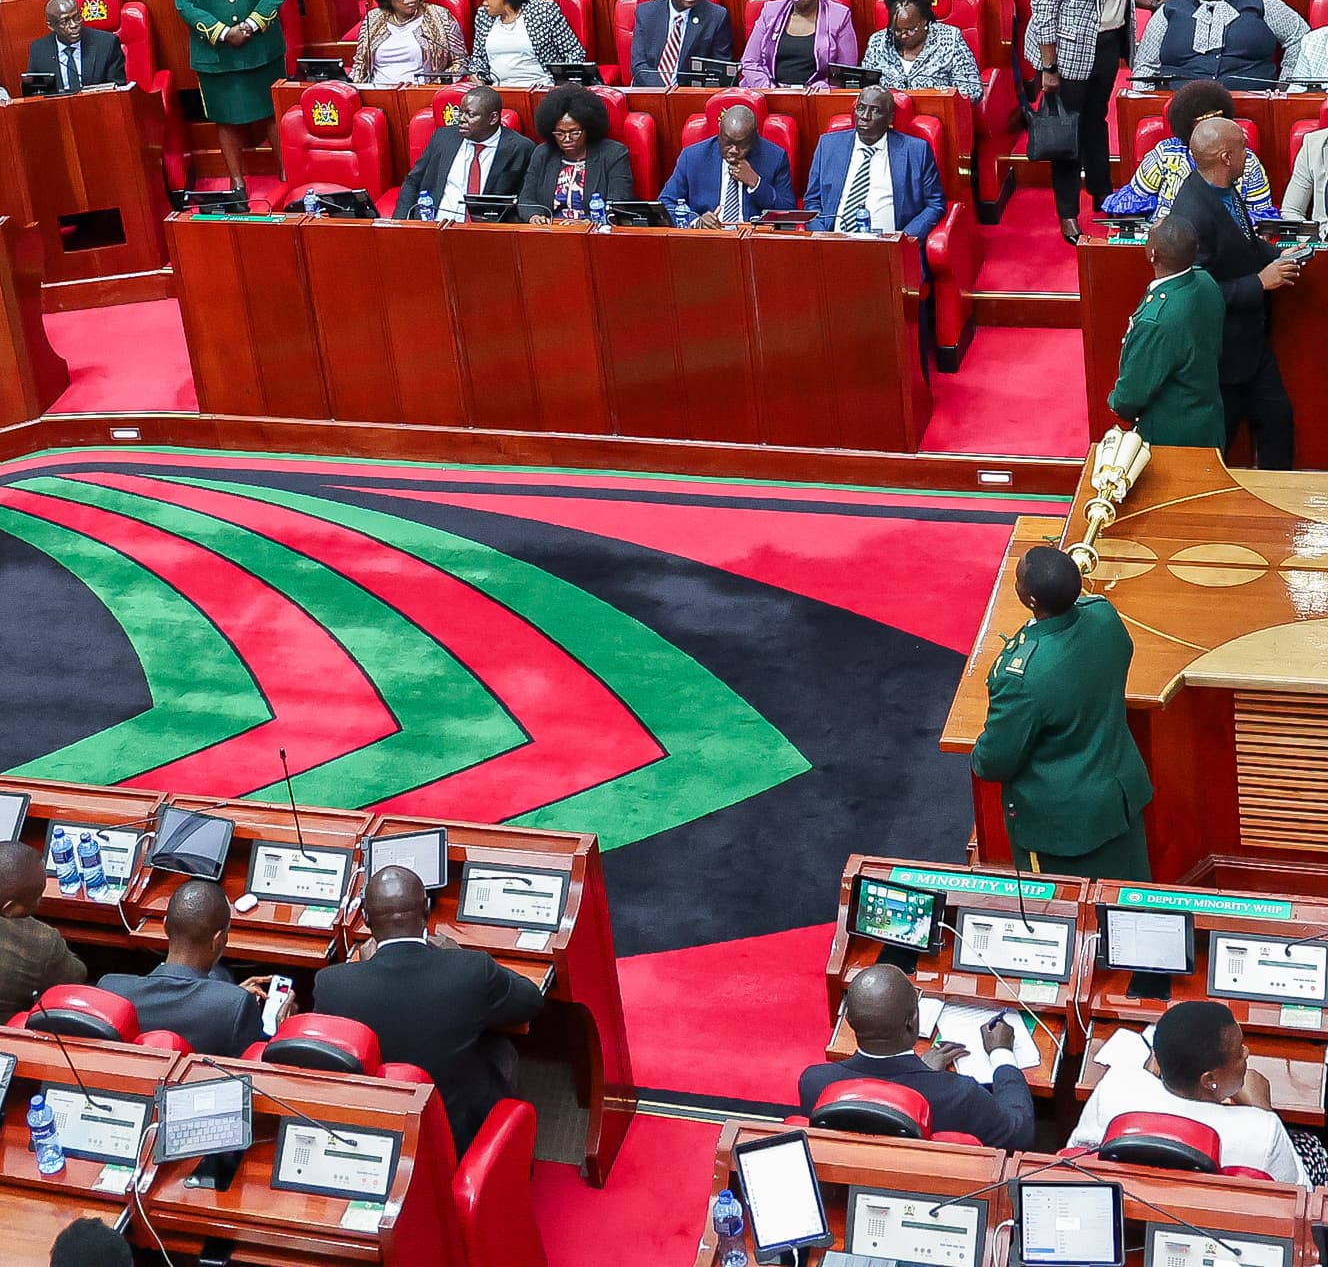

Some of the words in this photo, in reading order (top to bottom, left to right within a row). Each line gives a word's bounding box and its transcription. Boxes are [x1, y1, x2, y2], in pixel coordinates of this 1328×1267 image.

[916, 873, 1001, 893] MINORITY
[1146, 894, 1193, 908] DEPUTY
[1193, 899, 1251, 912] MINORITY
[1253, 903, 1283, 914] WHIP
